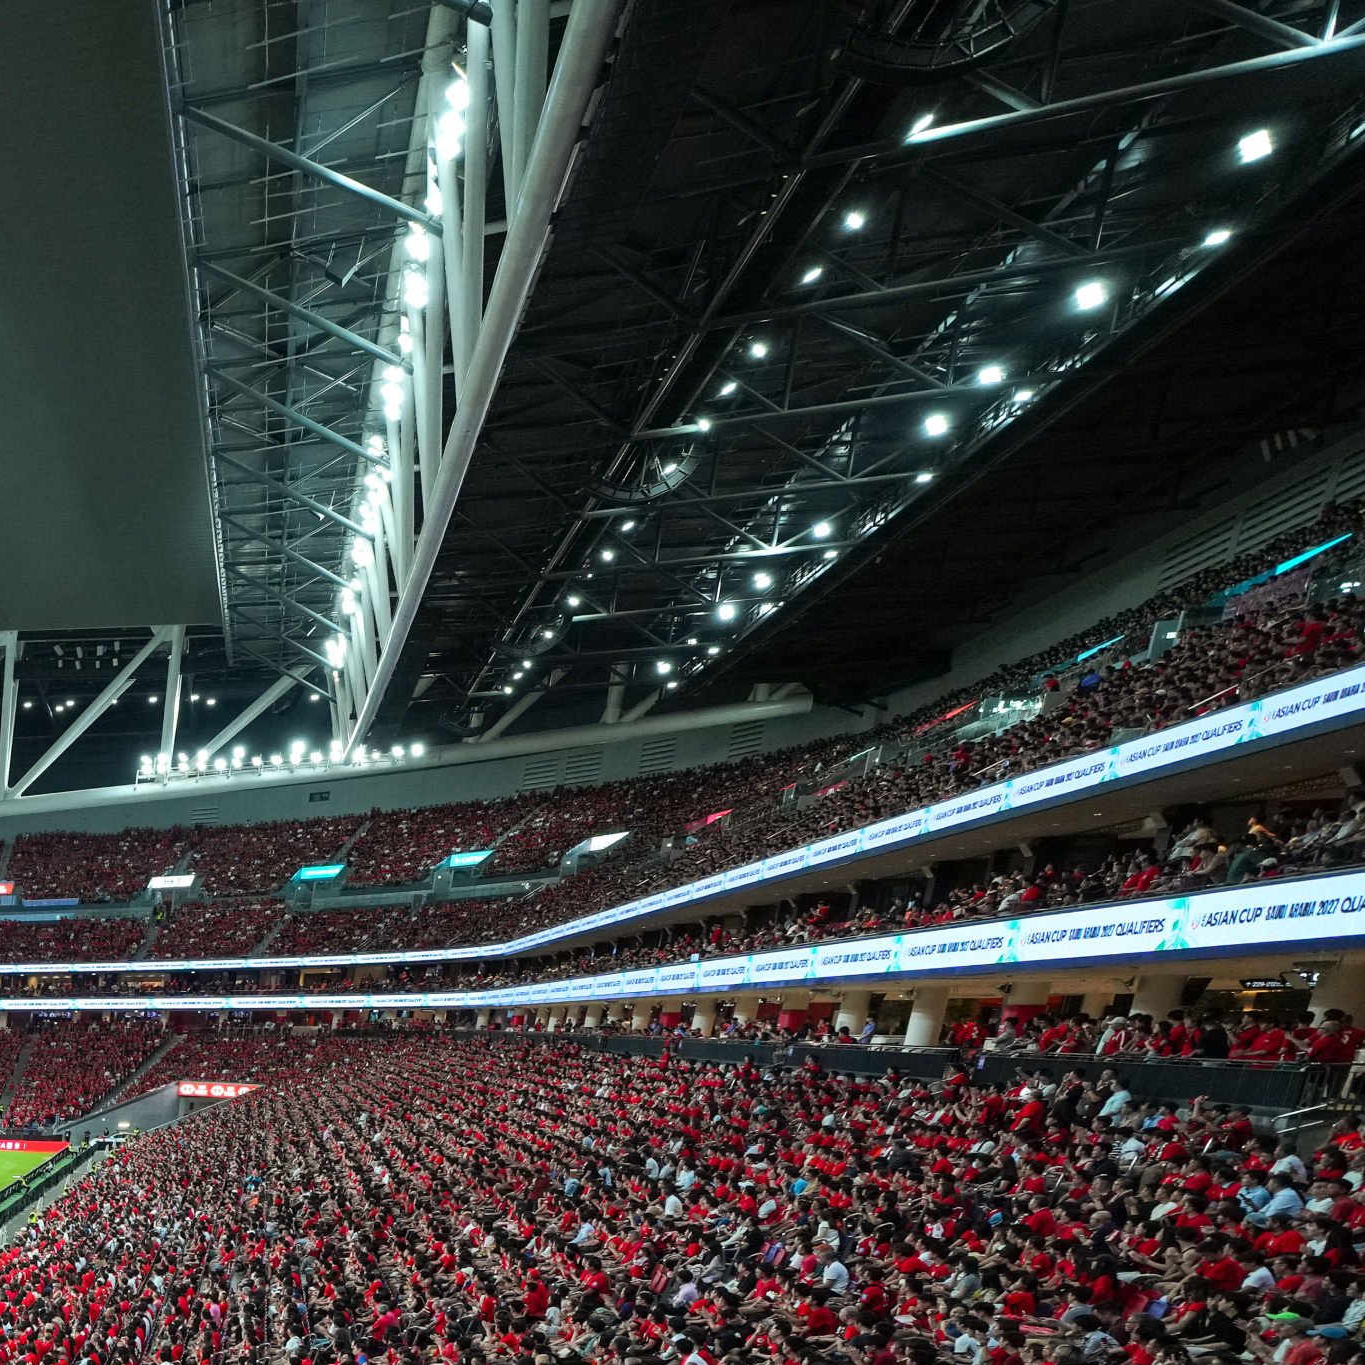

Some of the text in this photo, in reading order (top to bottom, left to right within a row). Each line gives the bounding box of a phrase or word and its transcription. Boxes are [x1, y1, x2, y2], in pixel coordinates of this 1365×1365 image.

[1275, 703, 1302, 720] ASIAN
[1302, 697, 1320, 712] CUP
[1129, 749, 1147, 763] ASIAN
[1147, 744, 1160, 758] CUP
[1201, 720, 1244, 741] QUALIFIERS
[1205, 909, 1238, 927] ASIAN
[1239, 907, 1263, 924] CUP
[1265, 904, 1287, 921] SAUDI
[1288, 901, 1316, 918] ARABIA
[1317, 898, 1339, 916] 2027
[1030, 931, 1050, 945] ASIAN
[1051, 929, 1067, 942] CUP
[1116, 918, 1166, 936] QUALIFIERS
